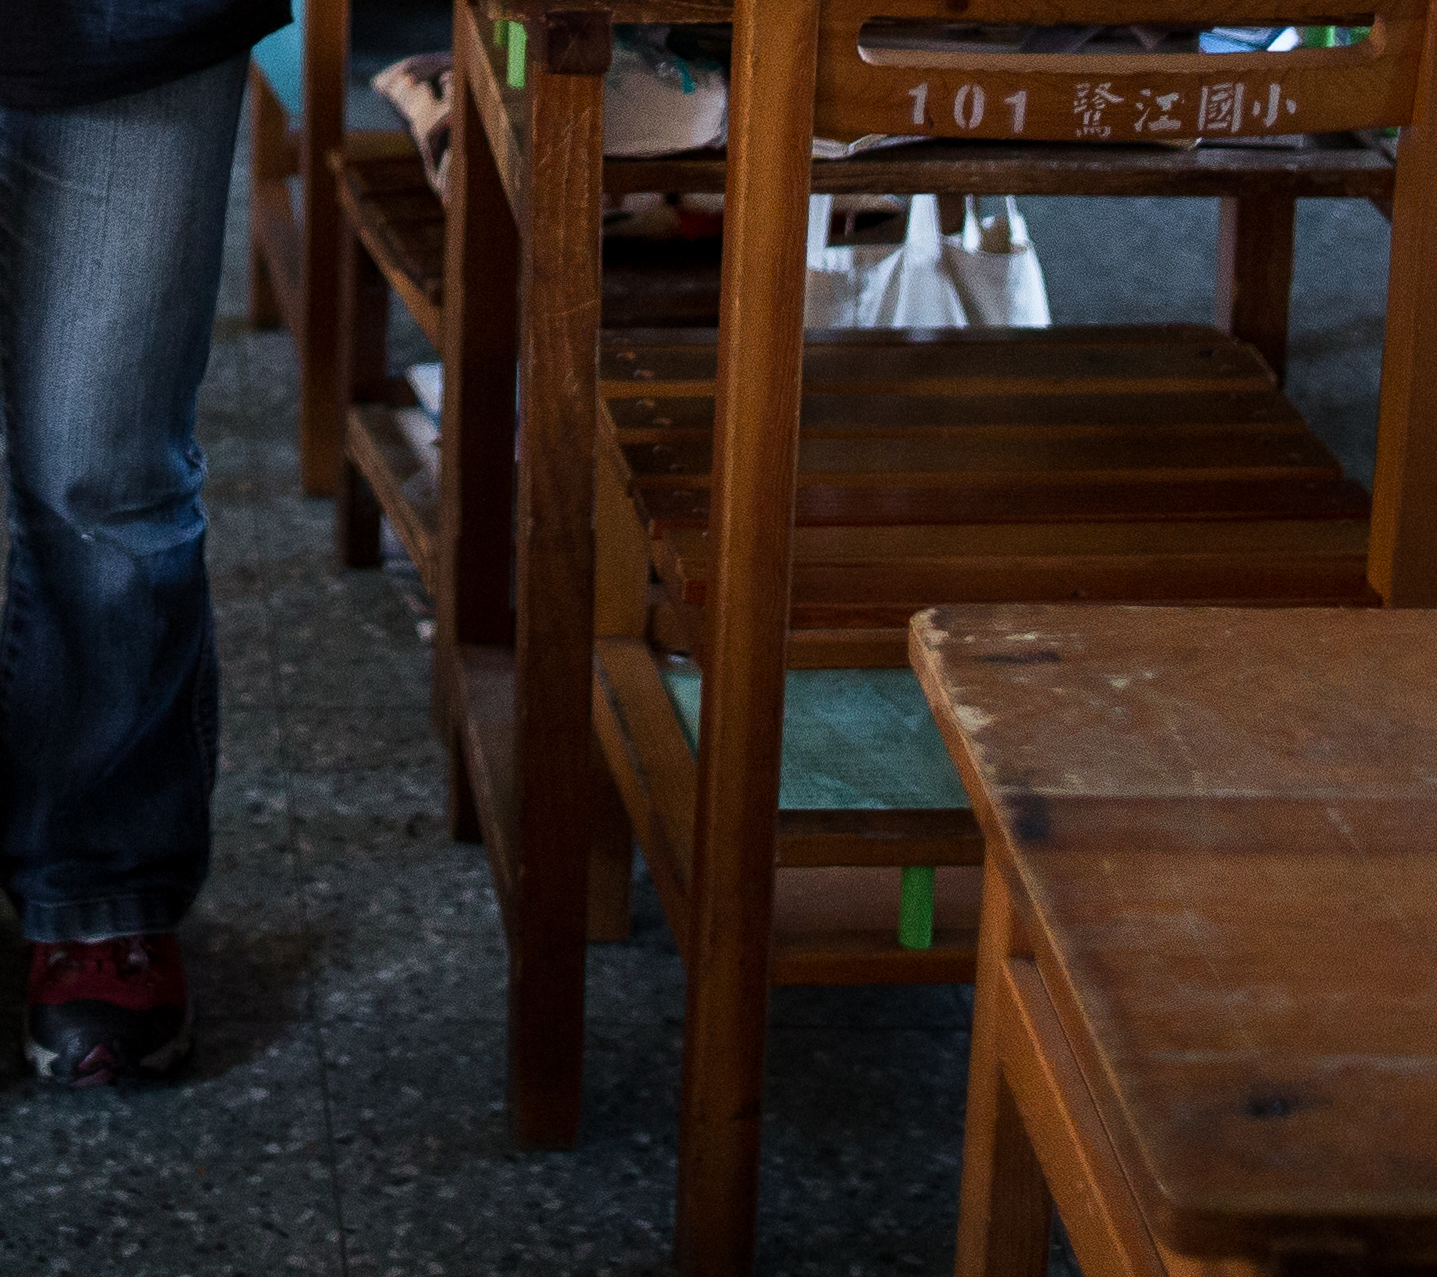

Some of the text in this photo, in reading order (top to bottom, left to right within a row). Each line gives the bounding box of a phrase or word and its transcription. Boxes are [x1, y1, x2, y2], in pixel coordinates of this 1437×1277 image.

[907, 80, 1297, 138] 101 鷺江國小
